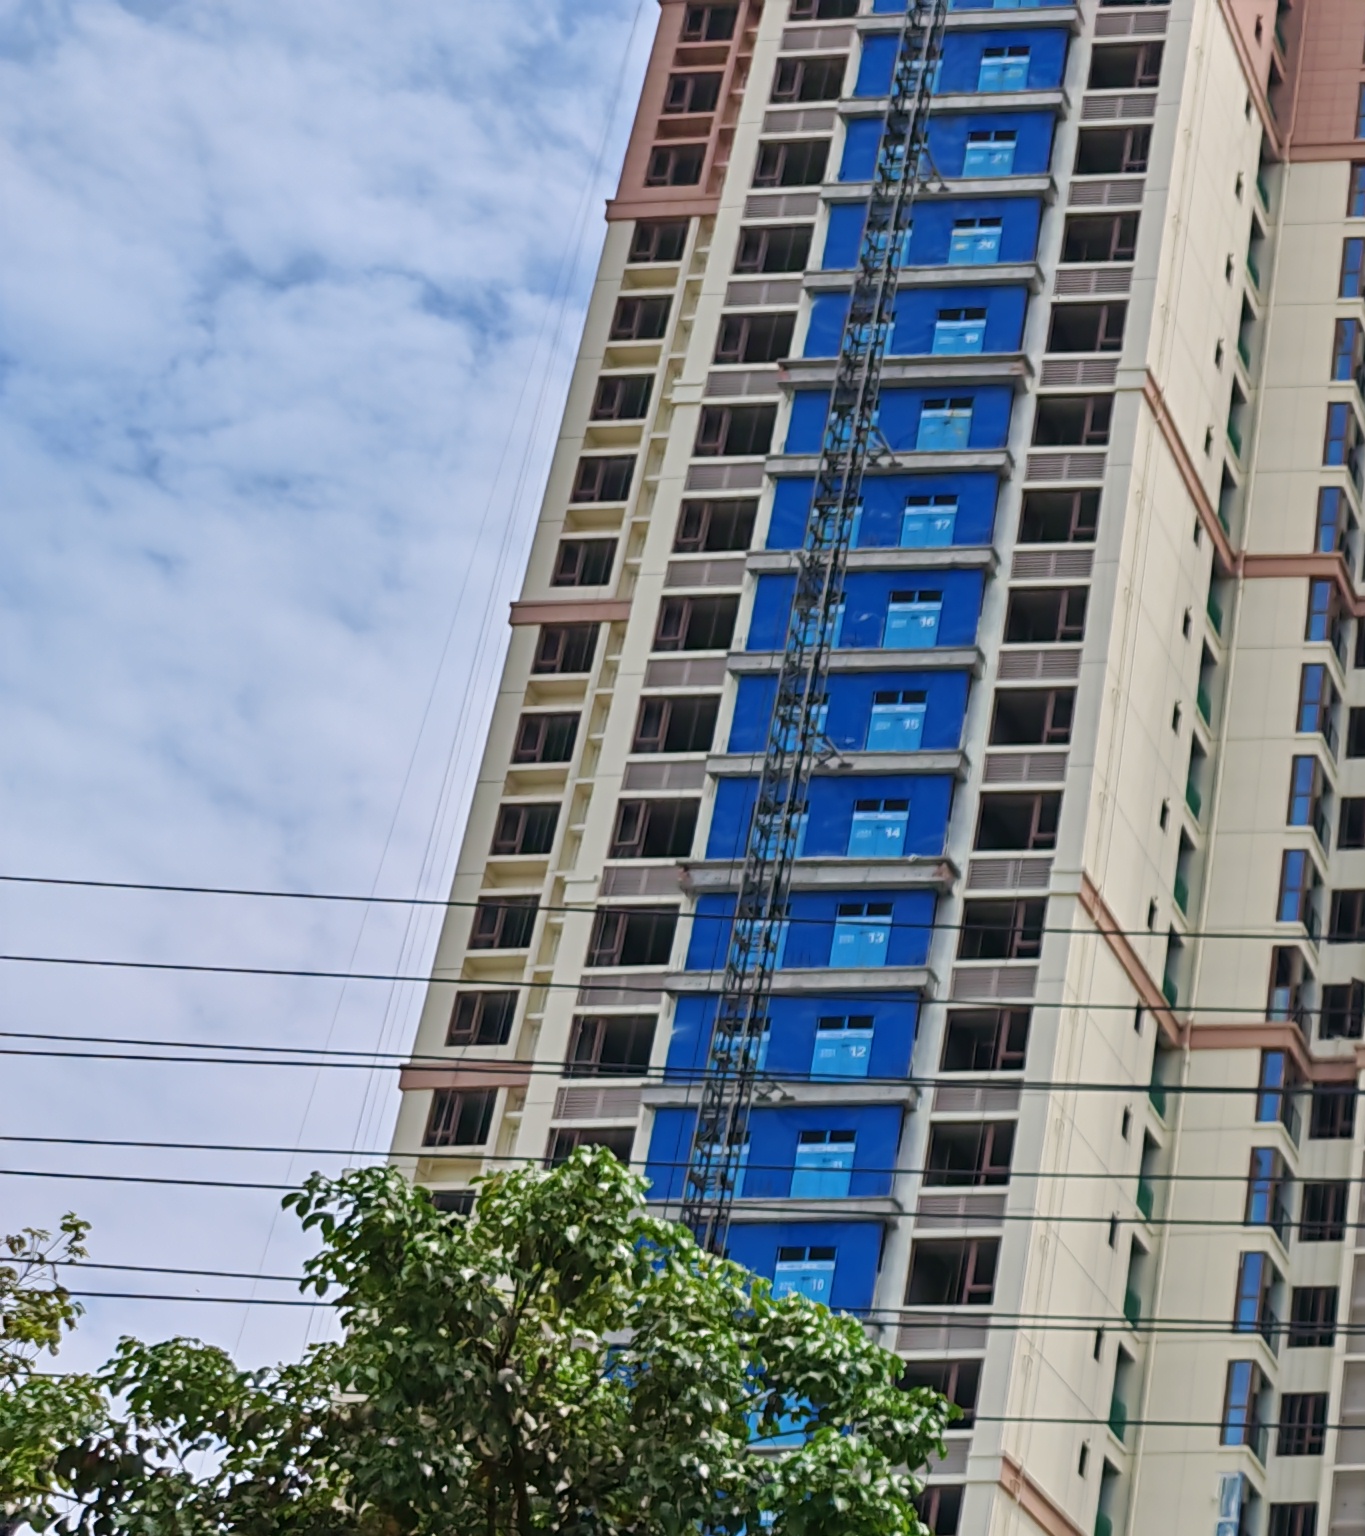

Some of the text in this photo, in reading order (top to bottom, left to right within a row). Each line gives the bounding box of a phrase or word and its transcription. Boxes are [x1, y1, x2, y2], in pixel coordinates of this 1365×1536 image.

[884, 827, 900, 838] 14
[868, 932, 884, 943] 13
[849, 1046, 866, 1057] 12
[812, 1279, 824, 1291] 10
